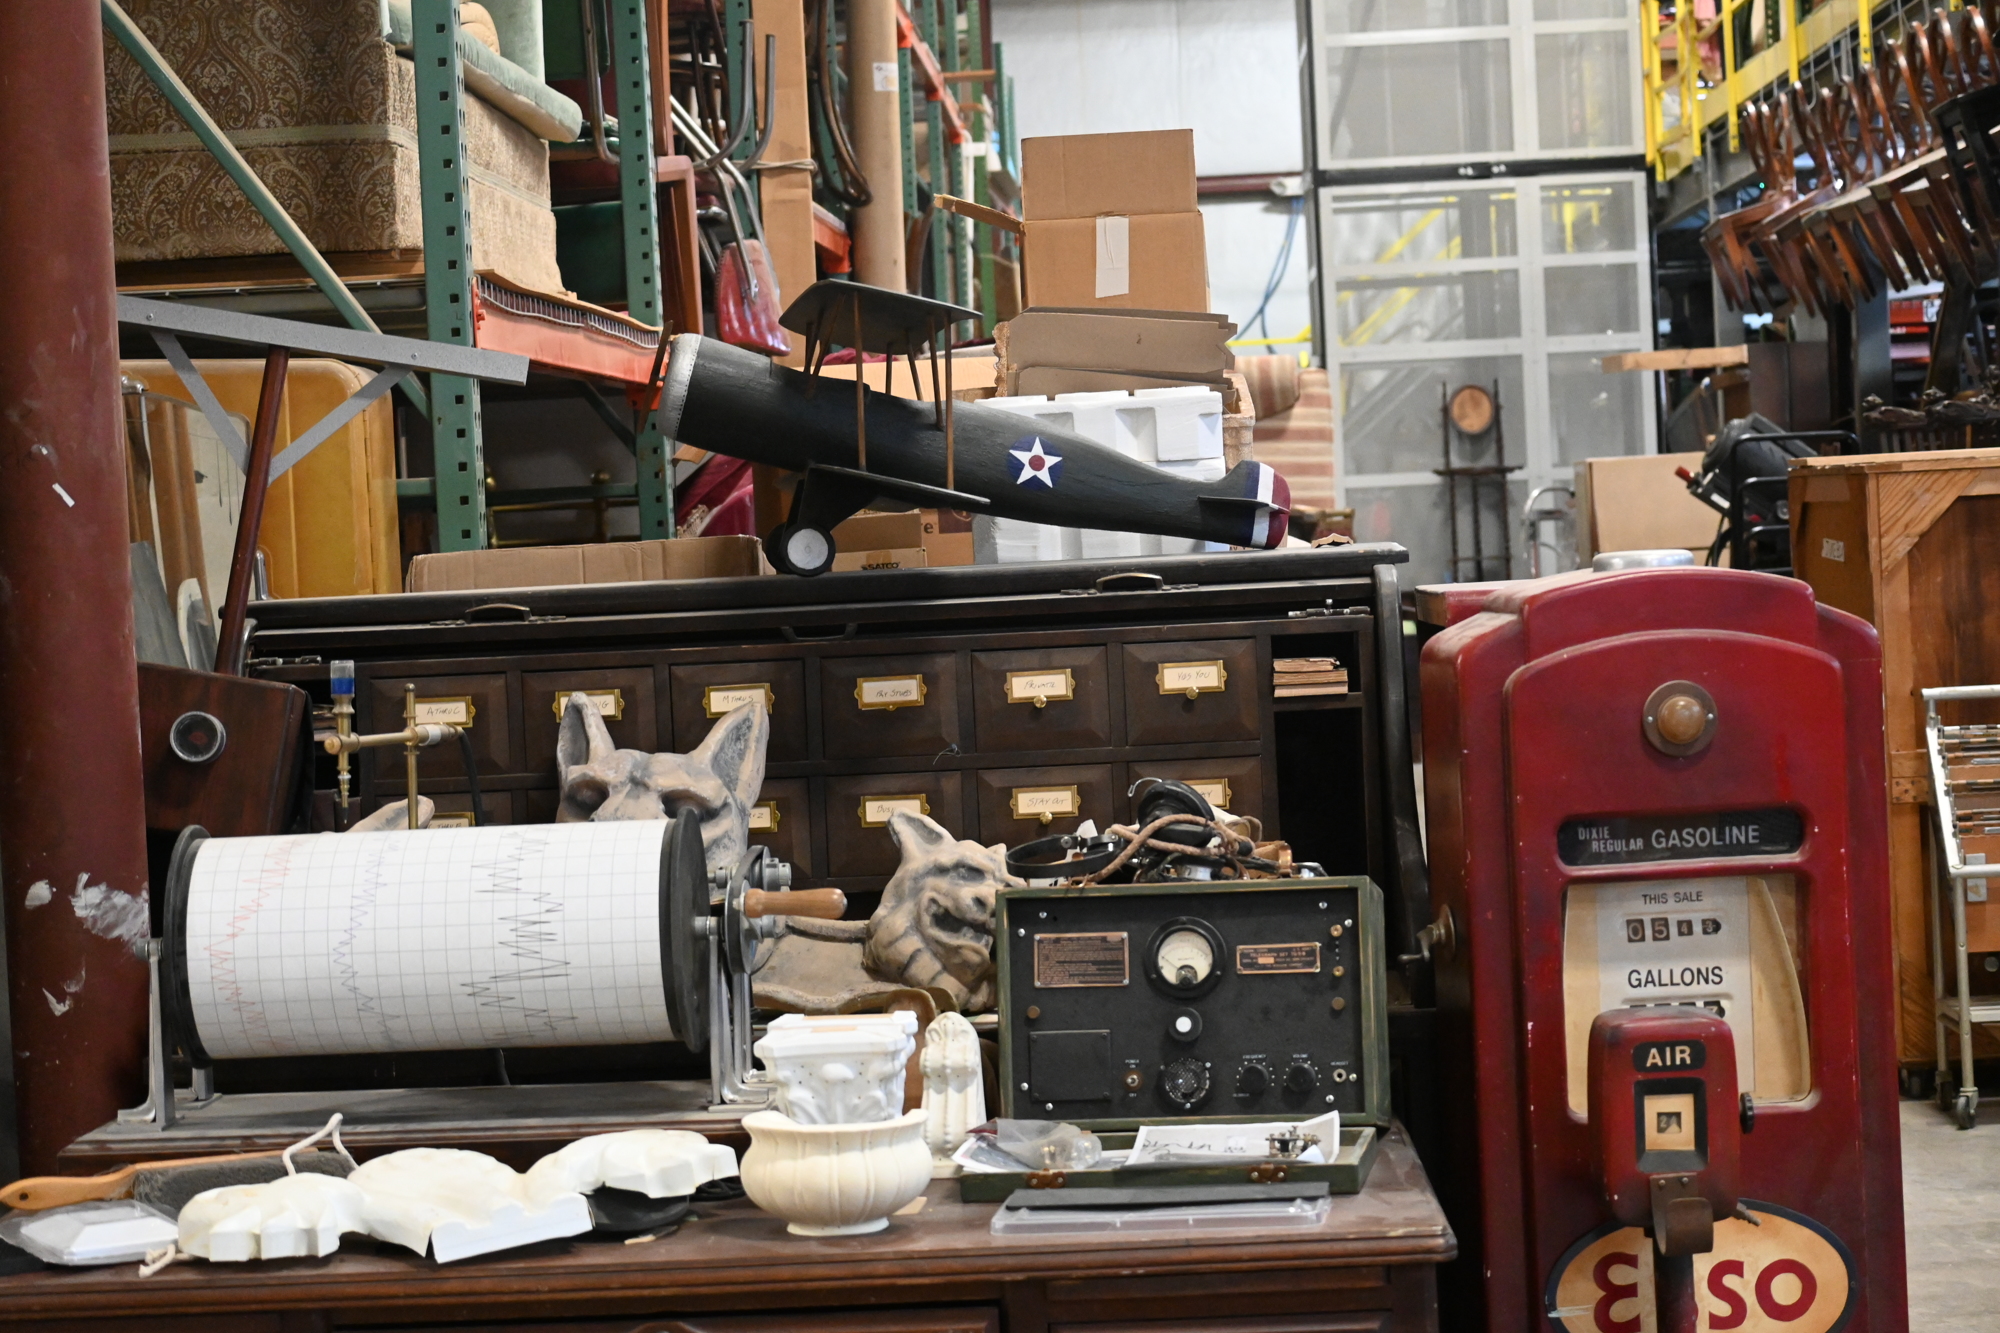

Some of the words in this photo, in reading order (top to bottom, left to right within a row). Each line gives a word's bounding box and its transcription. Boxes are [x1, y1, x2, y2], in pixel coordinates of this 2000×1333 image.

[868, 562, 899, 570] SATCO
[1195, 669, 1210, 679] YOU
[427, 706, 434, 716] A
[1027, 797, 1050, 807] STAY
[1578, 826, 1610, 840] DIXIE
[1651, 824, 1761, 850] GASOLINE
[1592, 838, 1644, 853] REGULAR
[1642, 893, 1669, 905] THIS
[1673, 890, 1704, 903] SALE
[1628, 965, 1724, 989] GALLONS
[1646, 1045, 1692, 1068] AIR
[1592, 1251, 1818, 1333] ESO
